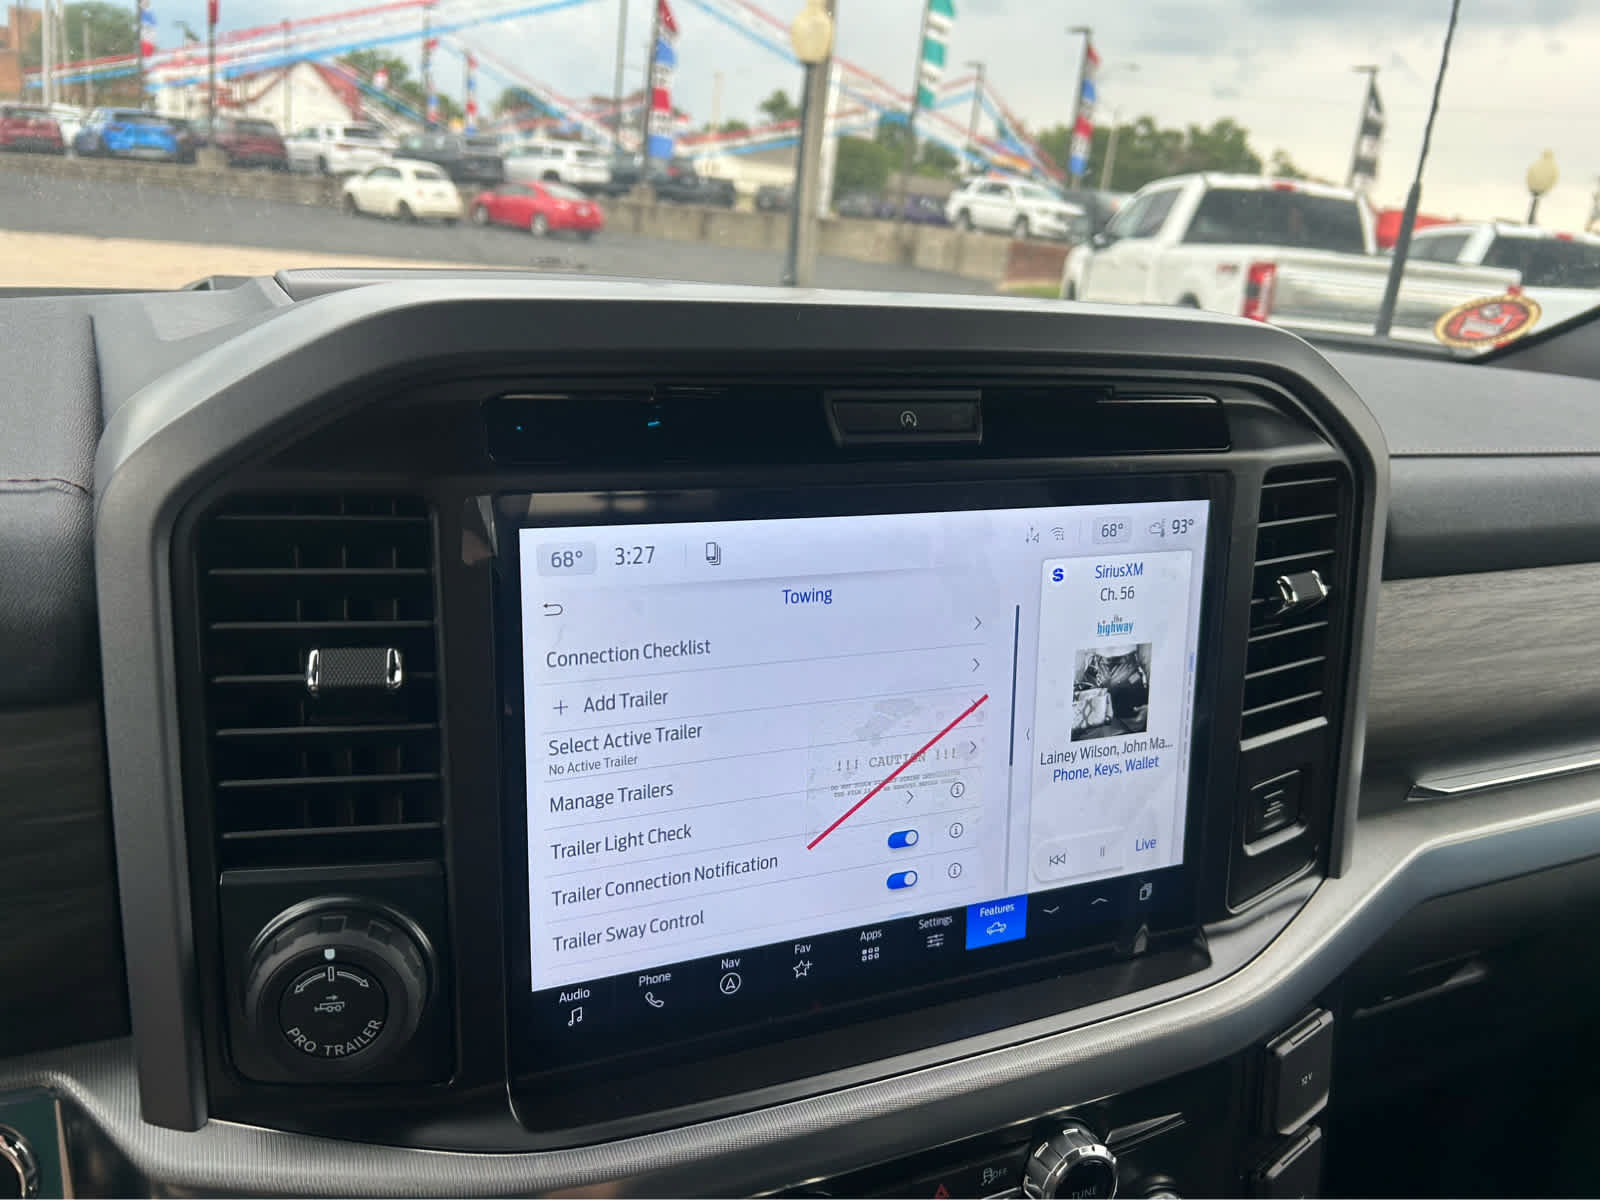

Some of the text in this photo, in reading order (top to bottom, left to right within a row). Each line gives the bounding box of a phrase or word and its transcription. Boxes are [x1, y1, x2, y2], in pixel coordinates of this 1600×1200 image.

[1101, 522, 1124, 538] 68°
[1171, 518, 1194, 535] 93°
[551, 550, 584, 568] 68°
[615, 546, 656, 565] 3:27
[1095, 562, 1144, 579] SiriusXM
[781, 587, 833, 605] Towing
[1100, 586, 1135, 601] Ch. 56
[1097, 619, 1134, 636] highway
[547, 639, 711, 668] Connection Checklist
[583, 690, 669, 713] Add Trailer
[548, 723, 703, 756] Select Active Trailer
[1040, 750, 1077, 766] Lainey
[1080, 743, 1120, 760] Wilson,
[1122, 739, 1147, 755] John
[548, 755, 638, 776] No Active Trailer
[1053, 756, 1160, 782] Phone, Keys, Wallet
[550, 783, 674, 813] Manage Trailers
[551, 824, 692, 860] Trailer Light Check
[1135, 838, 1157, 851] Live
[551, 856, 778, 906] Trailer Connection Notification
[979, 902, 1015, 917] Features
[553, 910, 704, 952] Trailer Sway Control
[918, 914, 953, 930] Settings
[860, 929, 882, 943] Apps
[794, 943, 812, 956] Fav
[720, 957, 741, 970] Nav
[639, 972, 672, 987] Phone
[559, 987, 591, 1004] Audio
[286, 1019, 383, 1056] PRO TRAILER
